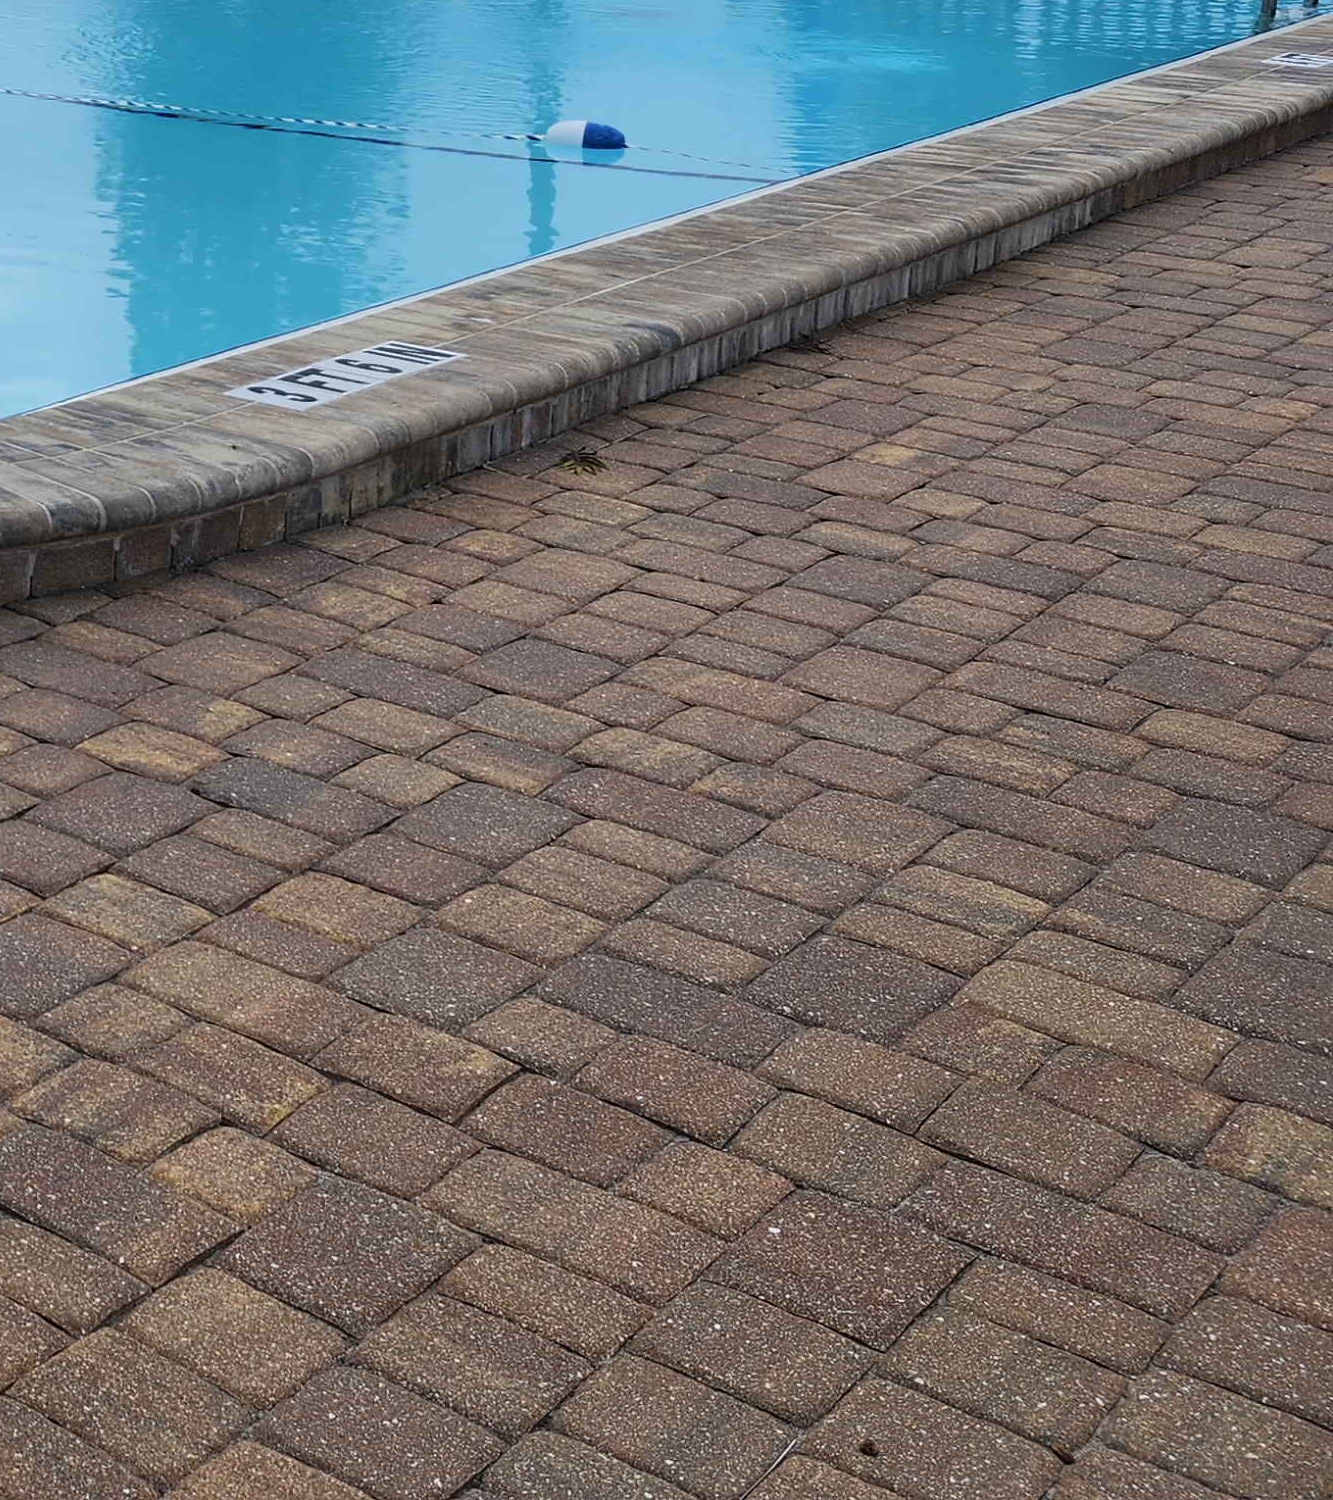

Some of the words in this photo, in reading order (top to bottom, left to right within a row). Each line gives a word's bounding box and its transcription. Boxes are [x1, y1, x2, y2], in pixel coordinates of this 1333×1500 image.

[363, 342, 457, 365] IN
[334, 357, 403, 374] 6
[277, 367, 372, 394] FT
[246, 385, 318, 403] 3
